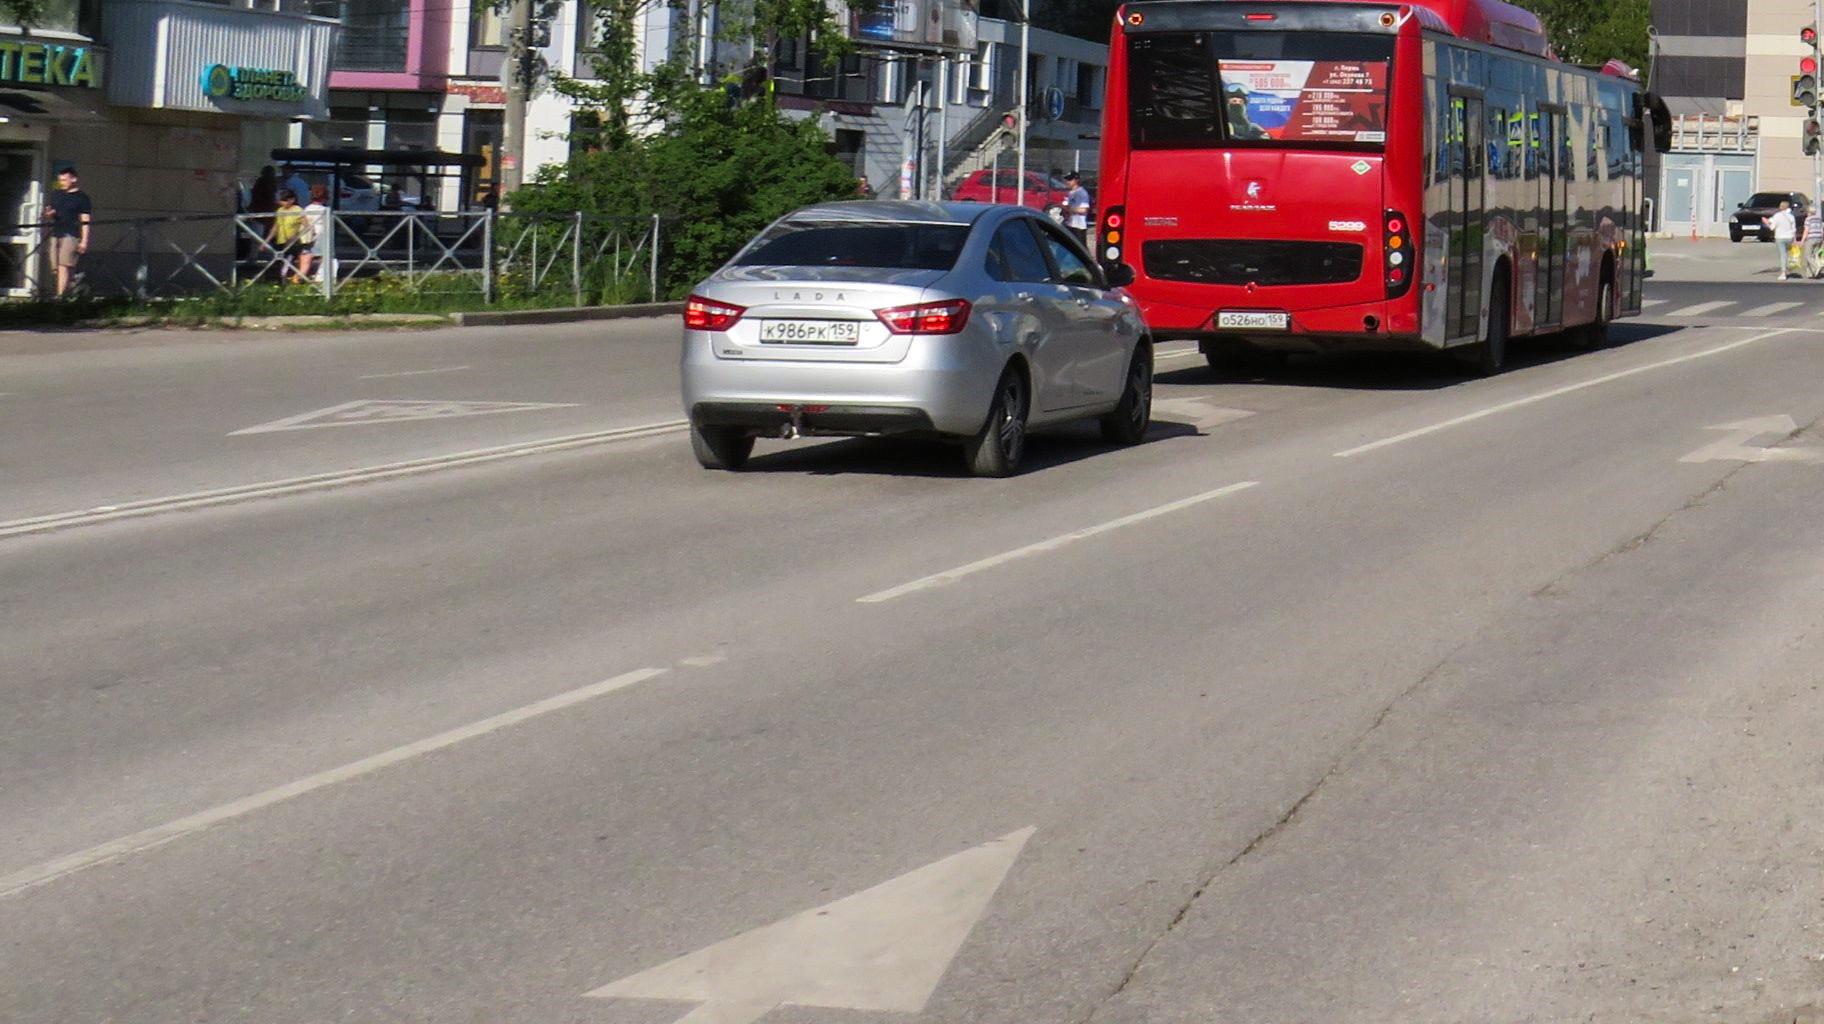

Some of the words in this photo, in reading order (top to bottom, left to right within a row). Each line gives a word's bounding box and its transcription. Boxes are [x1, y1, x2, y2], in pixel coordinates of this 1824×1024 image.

[774, 292, 845, 301] LADA
[765, 322, 827, 339] К986РК
[831, 323, 854, 336] 159
